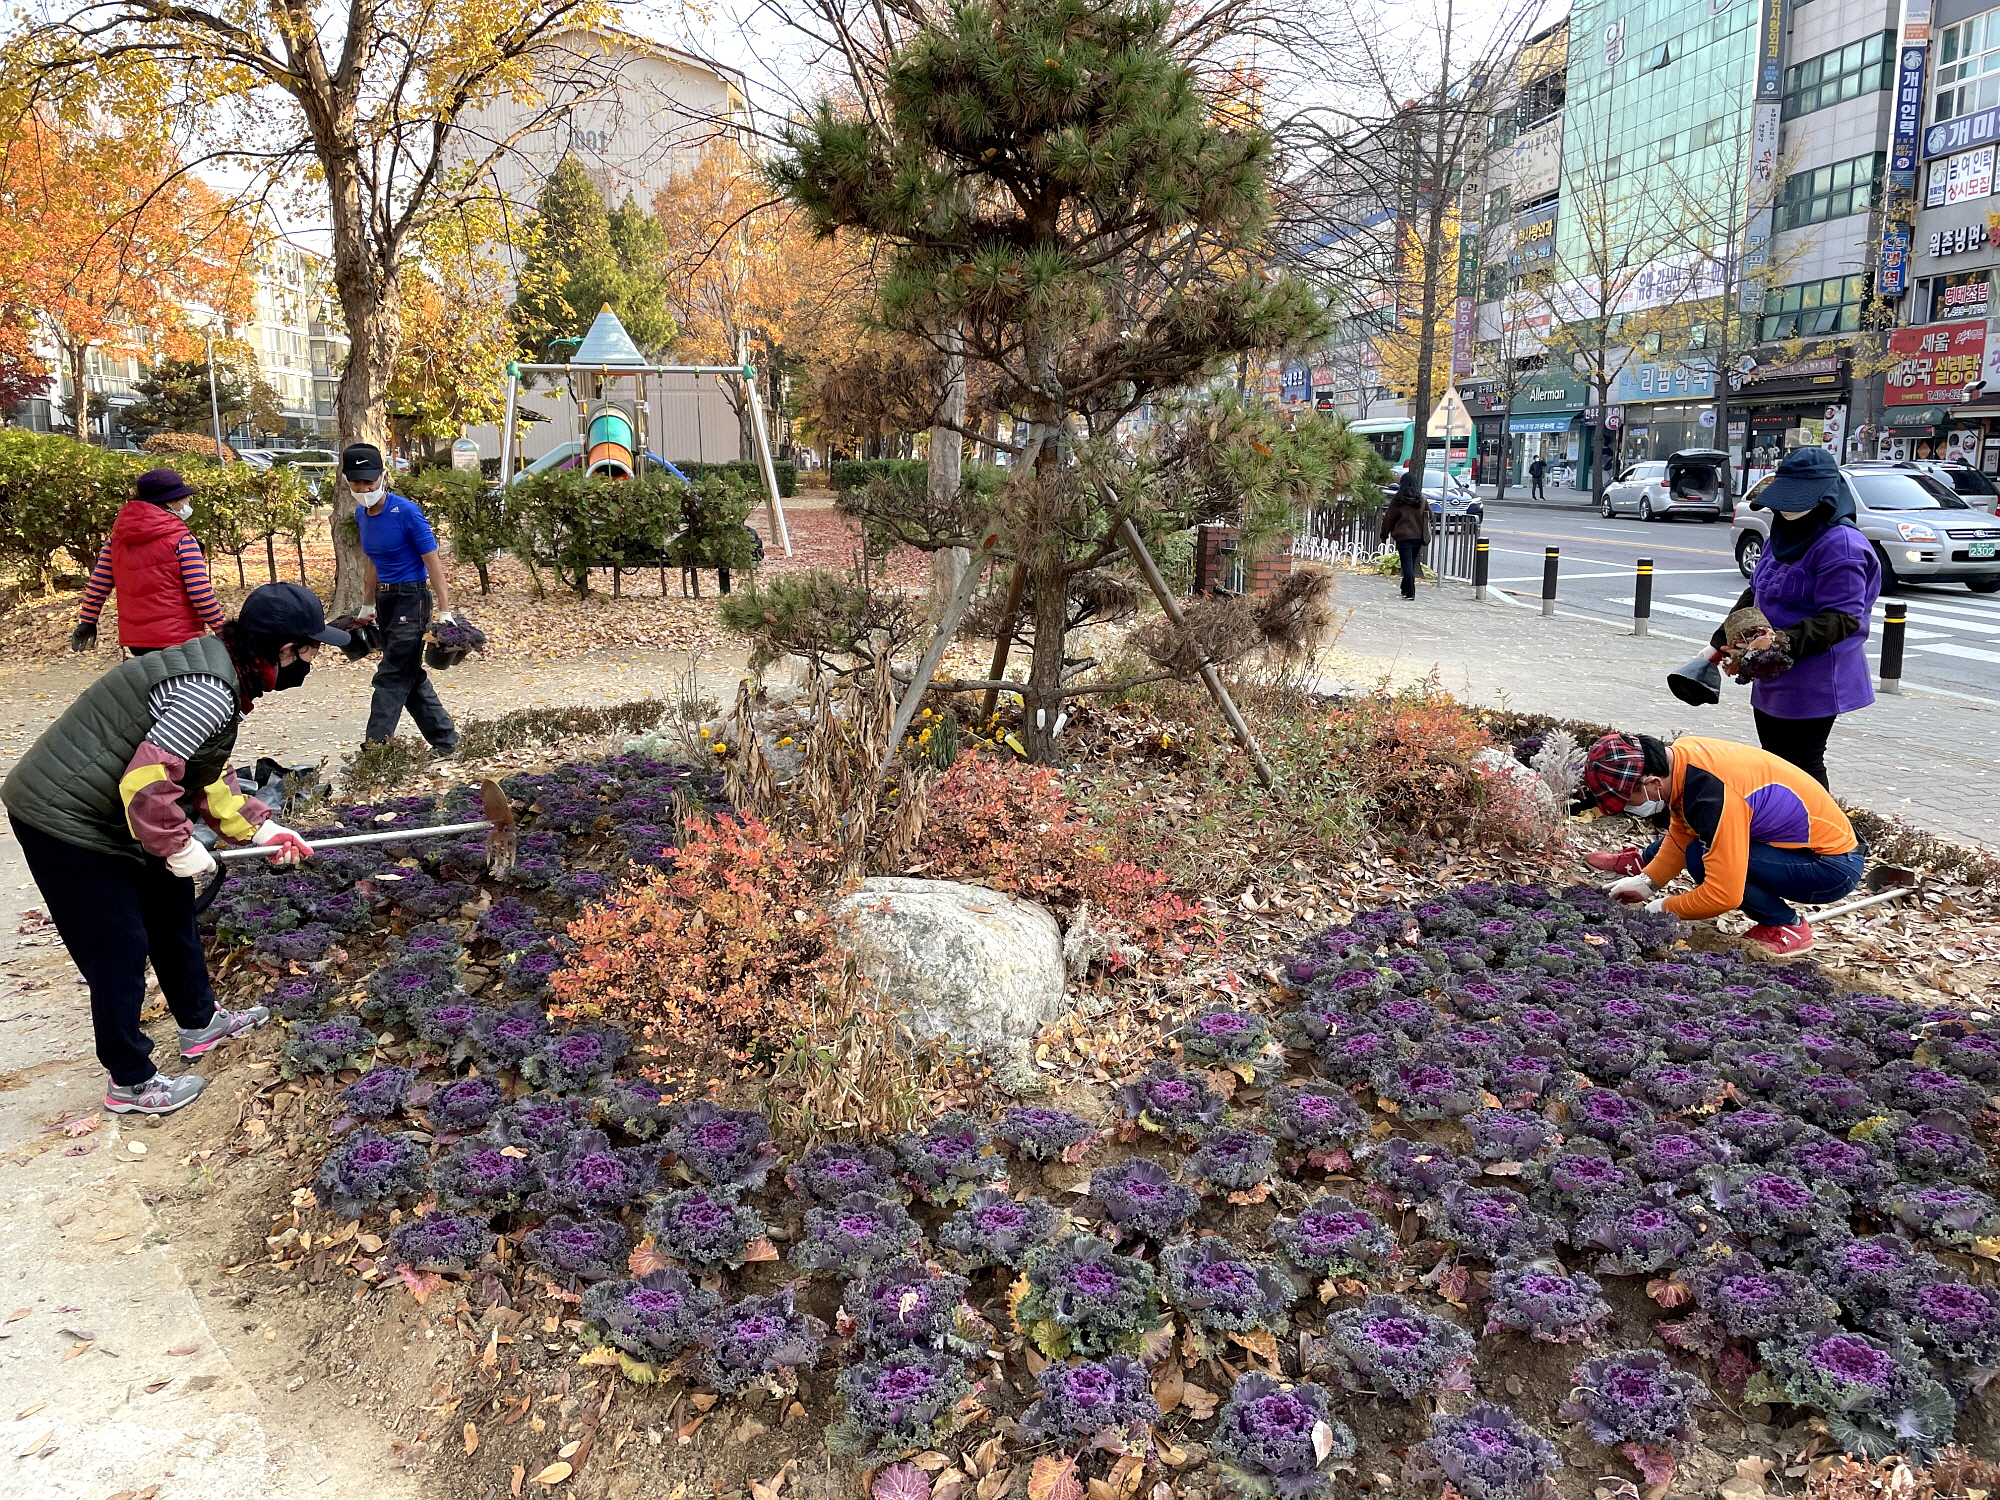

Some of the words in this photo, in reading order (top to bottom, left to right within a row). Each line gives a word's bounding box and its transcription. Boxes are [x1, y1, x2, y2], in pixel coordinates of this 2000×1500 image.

[1900, 71, 1919, 136] 개미인력
[1948, 111, 2000, 147] 개미
[1948, 176, 1990, 201] 상시모집
[1744, 235, 1766, 307] 리팜국
[1945, 282, 1989, 305] 명태조림
[1641, 363, 1710, 395] 리팜약국
[1934, 354, 1981, 385] 설렁탕
[1530, 387, 1565, 402] Allerman
[1927, 389, 1964, 401] T.401-825
[1610, 418, 1619, 428] 약
[1970, 547, 1995, 556] 2302
